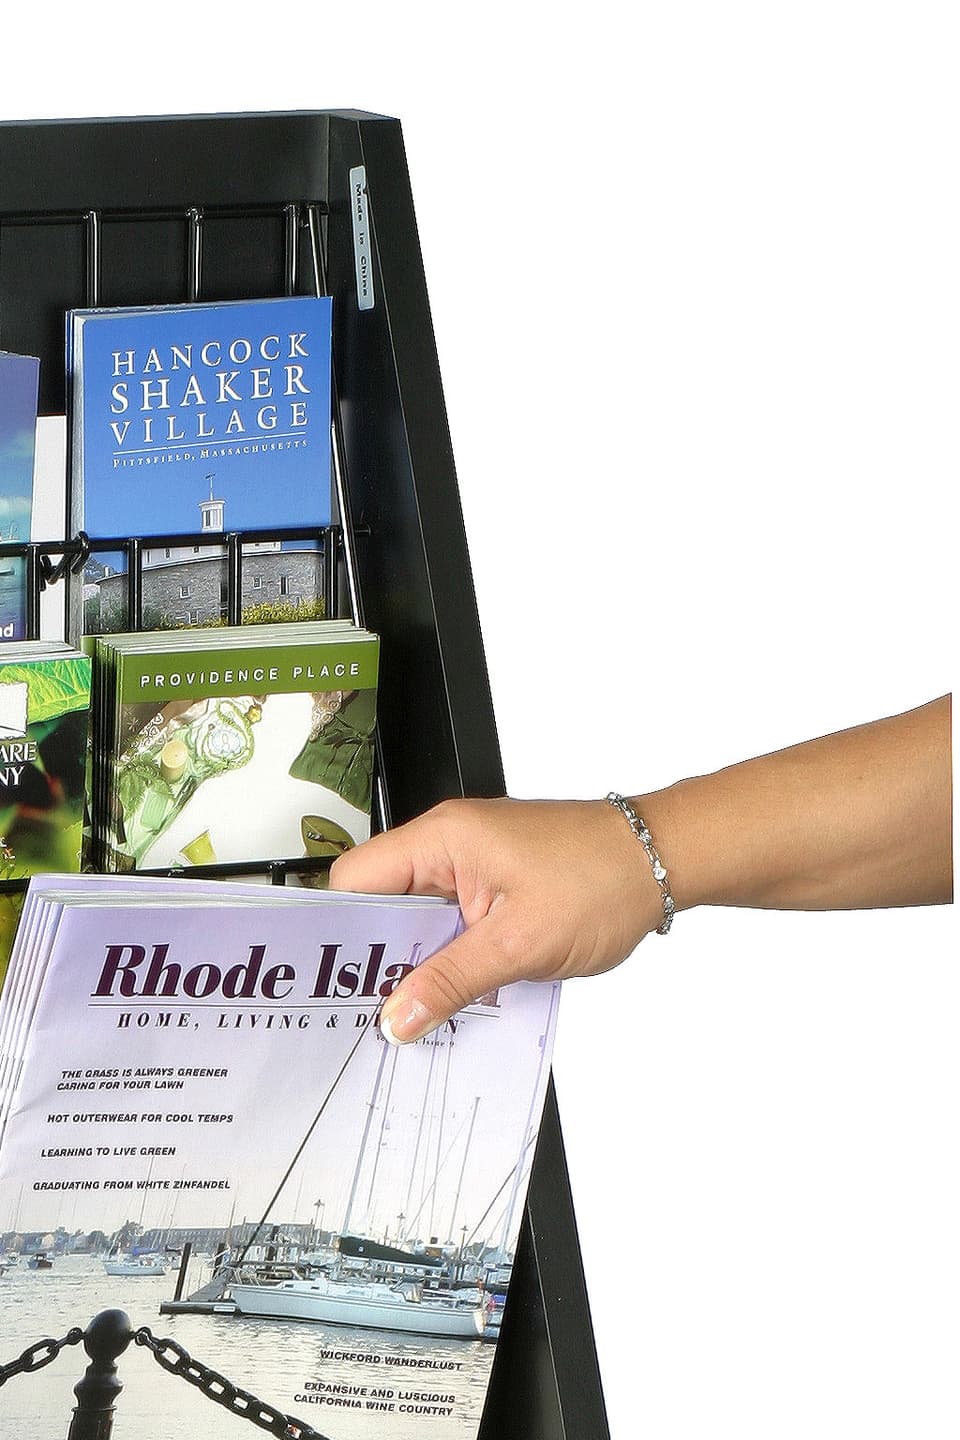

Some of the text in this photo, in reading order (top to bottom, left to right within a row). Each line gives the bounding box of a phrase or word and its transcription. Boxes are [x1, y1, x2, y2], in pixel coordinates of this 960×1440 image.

[355, 183, 363, 222] Made
[360, 256, 368, 297] China
[112, 333, 309, 377] HANCOCK
[110, 365, 311, 415] SHAKER
[110, 402, 308, 446] VILLAGE
[140, 662, 360, 688] PROVIDENCE PLACE
[90, 943, 296, 1000] Rhode
[116, 1012, 201, 1031] HOME,
[216, 1012, 310, 1030] LIVING
[326, 1014, 341, 1029] &
[61, 1068, 229, 1079] THE GRASS IS ALWAYS GREENER
[56, 1081, 184, 1091] CARING FOR YOUR LAWN
[47, 1113, 234, 1123] HOT OUTERWEAR FOR COOL TEMPS
[41, 1147, 176, 1158] LEARNING TO LIVE GREEN
[33, 1180, 231, 1191] GRADUATING FROM WHITE ZINFANDEL
[320, 1350, 462, 1371] WICKFORD WANDERLUST
[304, 1382, 455, 1404] EXPANSIVE AND LUSCIOUS
[294, 1394, 454, 1416] CALIFORNIA WINE COUNTRY
